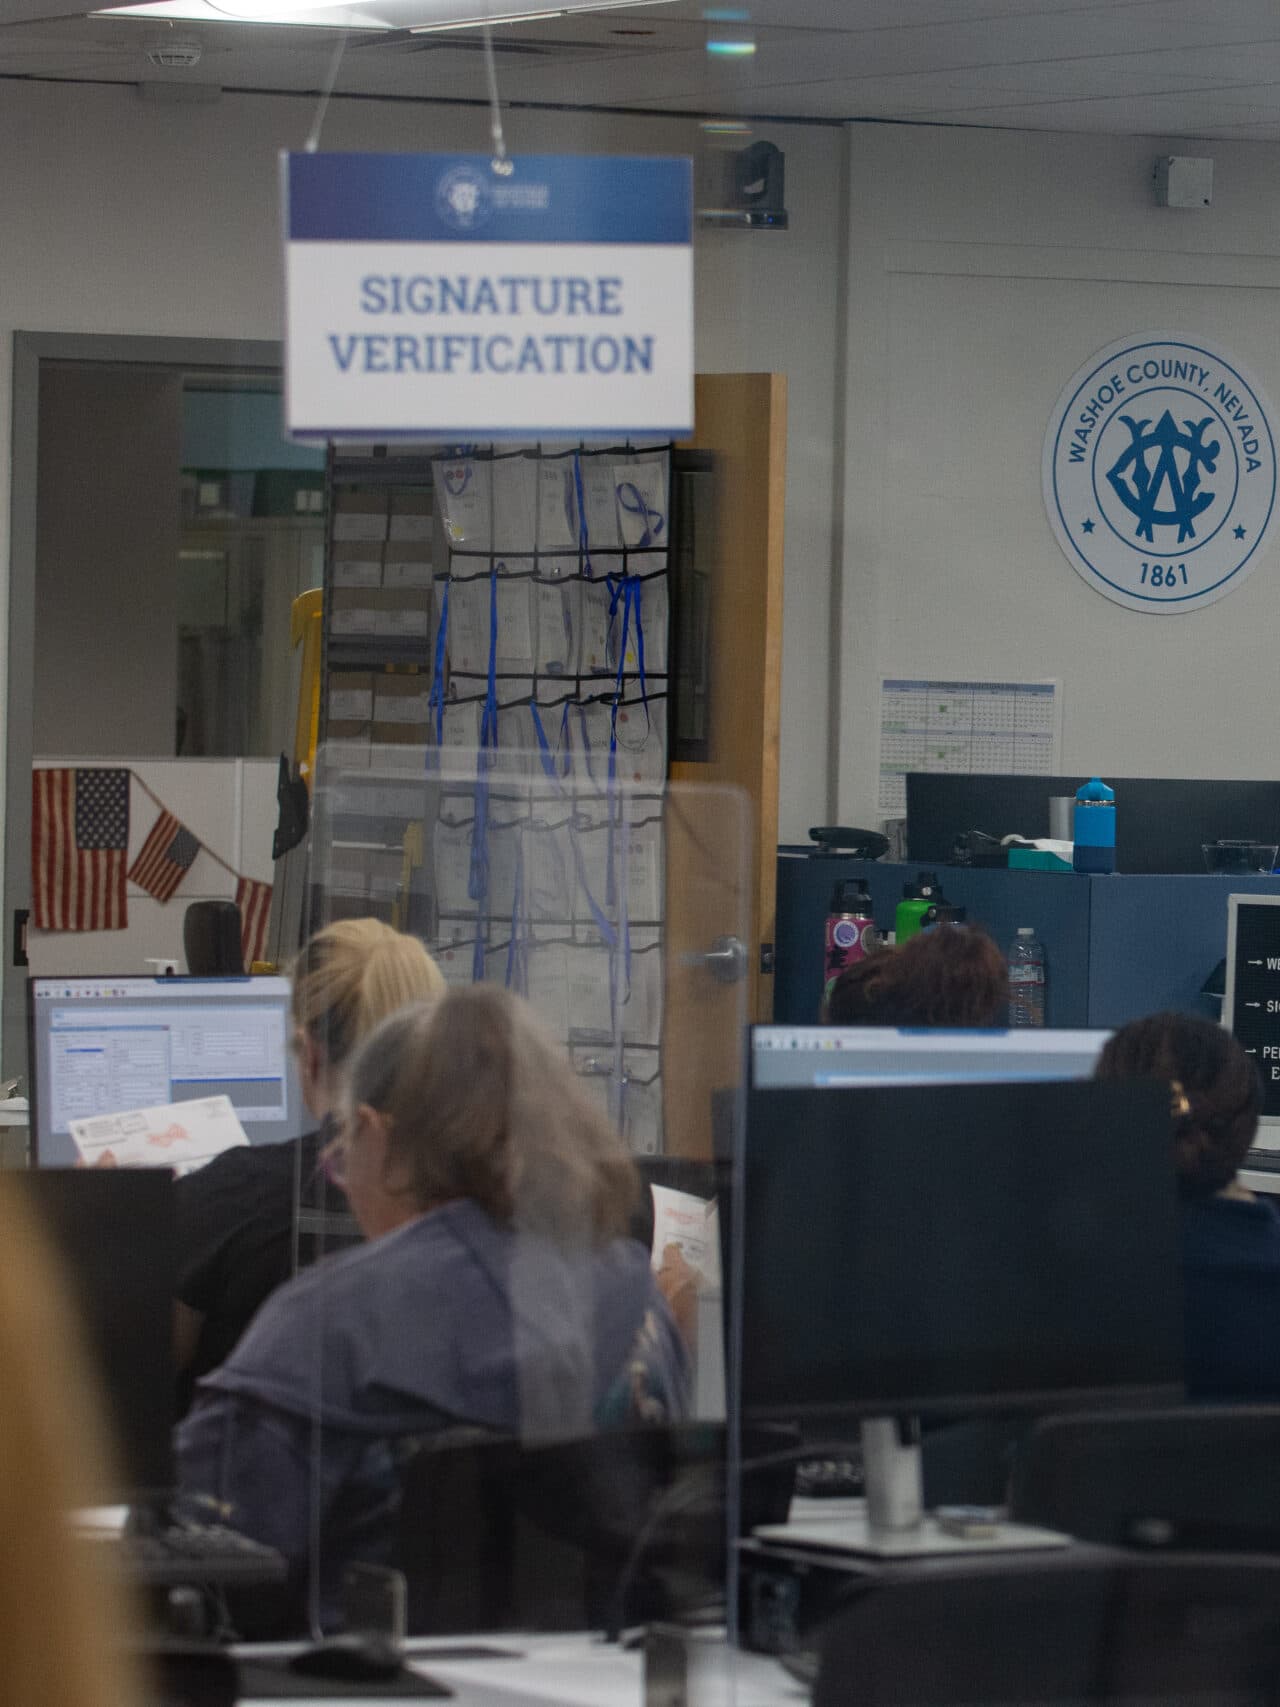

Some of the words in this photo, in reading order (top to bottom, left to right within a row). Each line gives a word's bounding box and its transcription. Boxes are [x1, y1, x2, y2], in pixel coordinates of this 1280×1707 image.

[360, 275, 623, 315] SIGNATURE
[328, 335, 655, 373] VERIFICATION
[1068, 375, 1126, 464] WASHOE
[1126, 360, 1210, 392] COUNTY,
[1213, 383, 1262, 473] NEVADA
[1140, 562, 1188, 587] 1861
